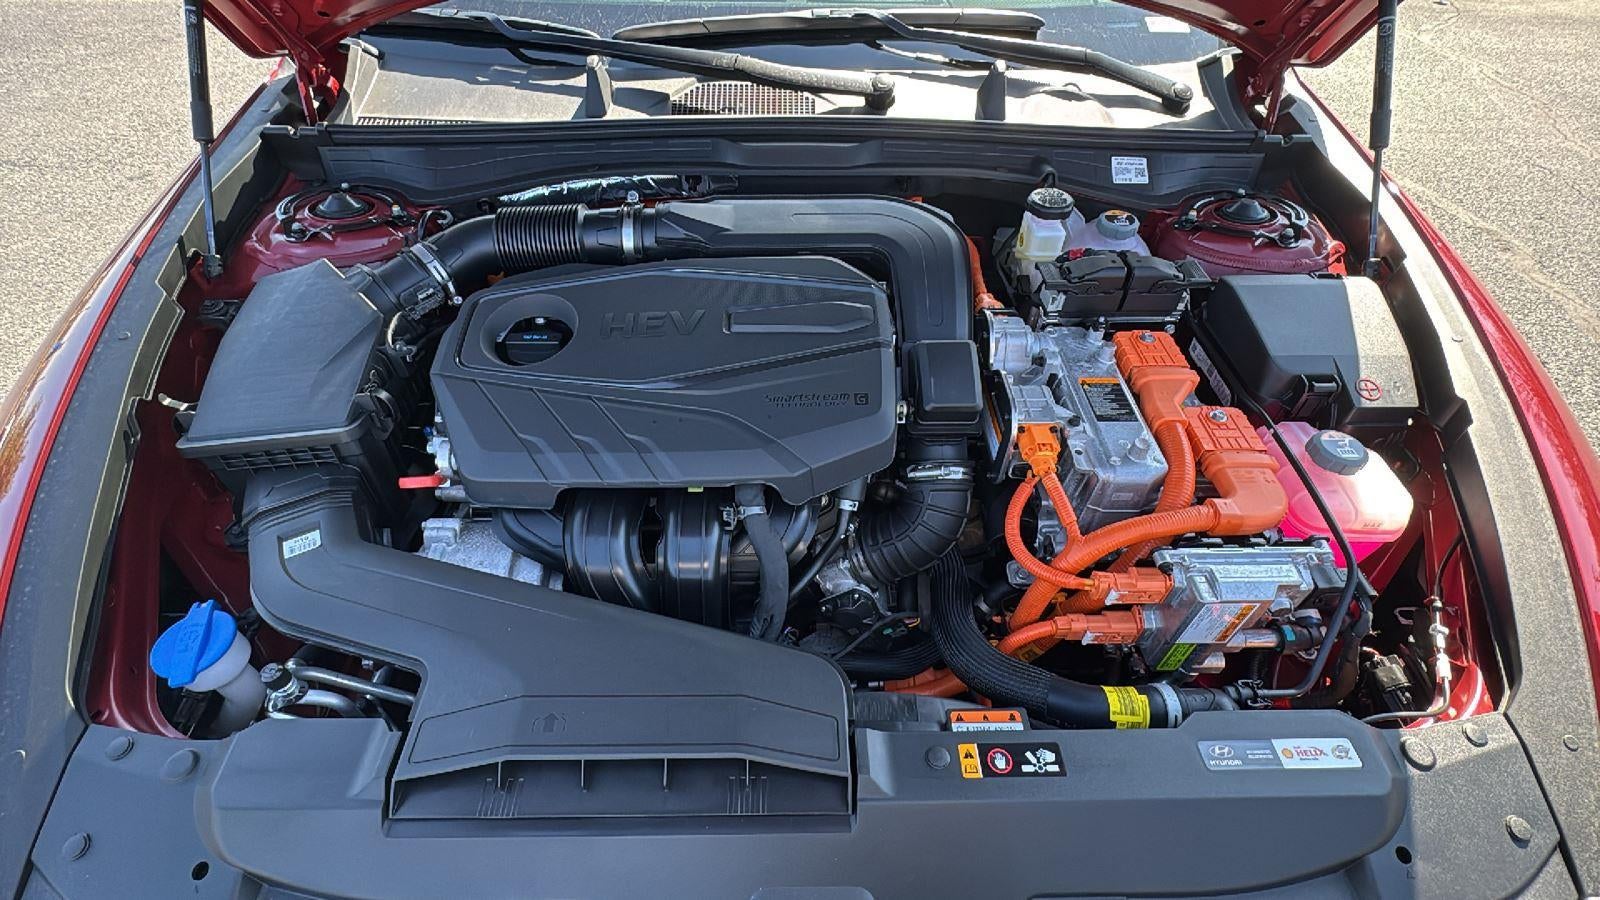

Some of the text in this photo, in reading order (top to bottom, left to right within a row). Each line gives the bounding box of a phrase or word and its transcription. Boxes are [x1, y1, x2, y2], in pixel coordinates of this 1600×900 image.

[600, 309, 706, 338] HEV
[765, 393, 850, 403] Smartstream
[1294, 748, 1325, 757] HELIX
